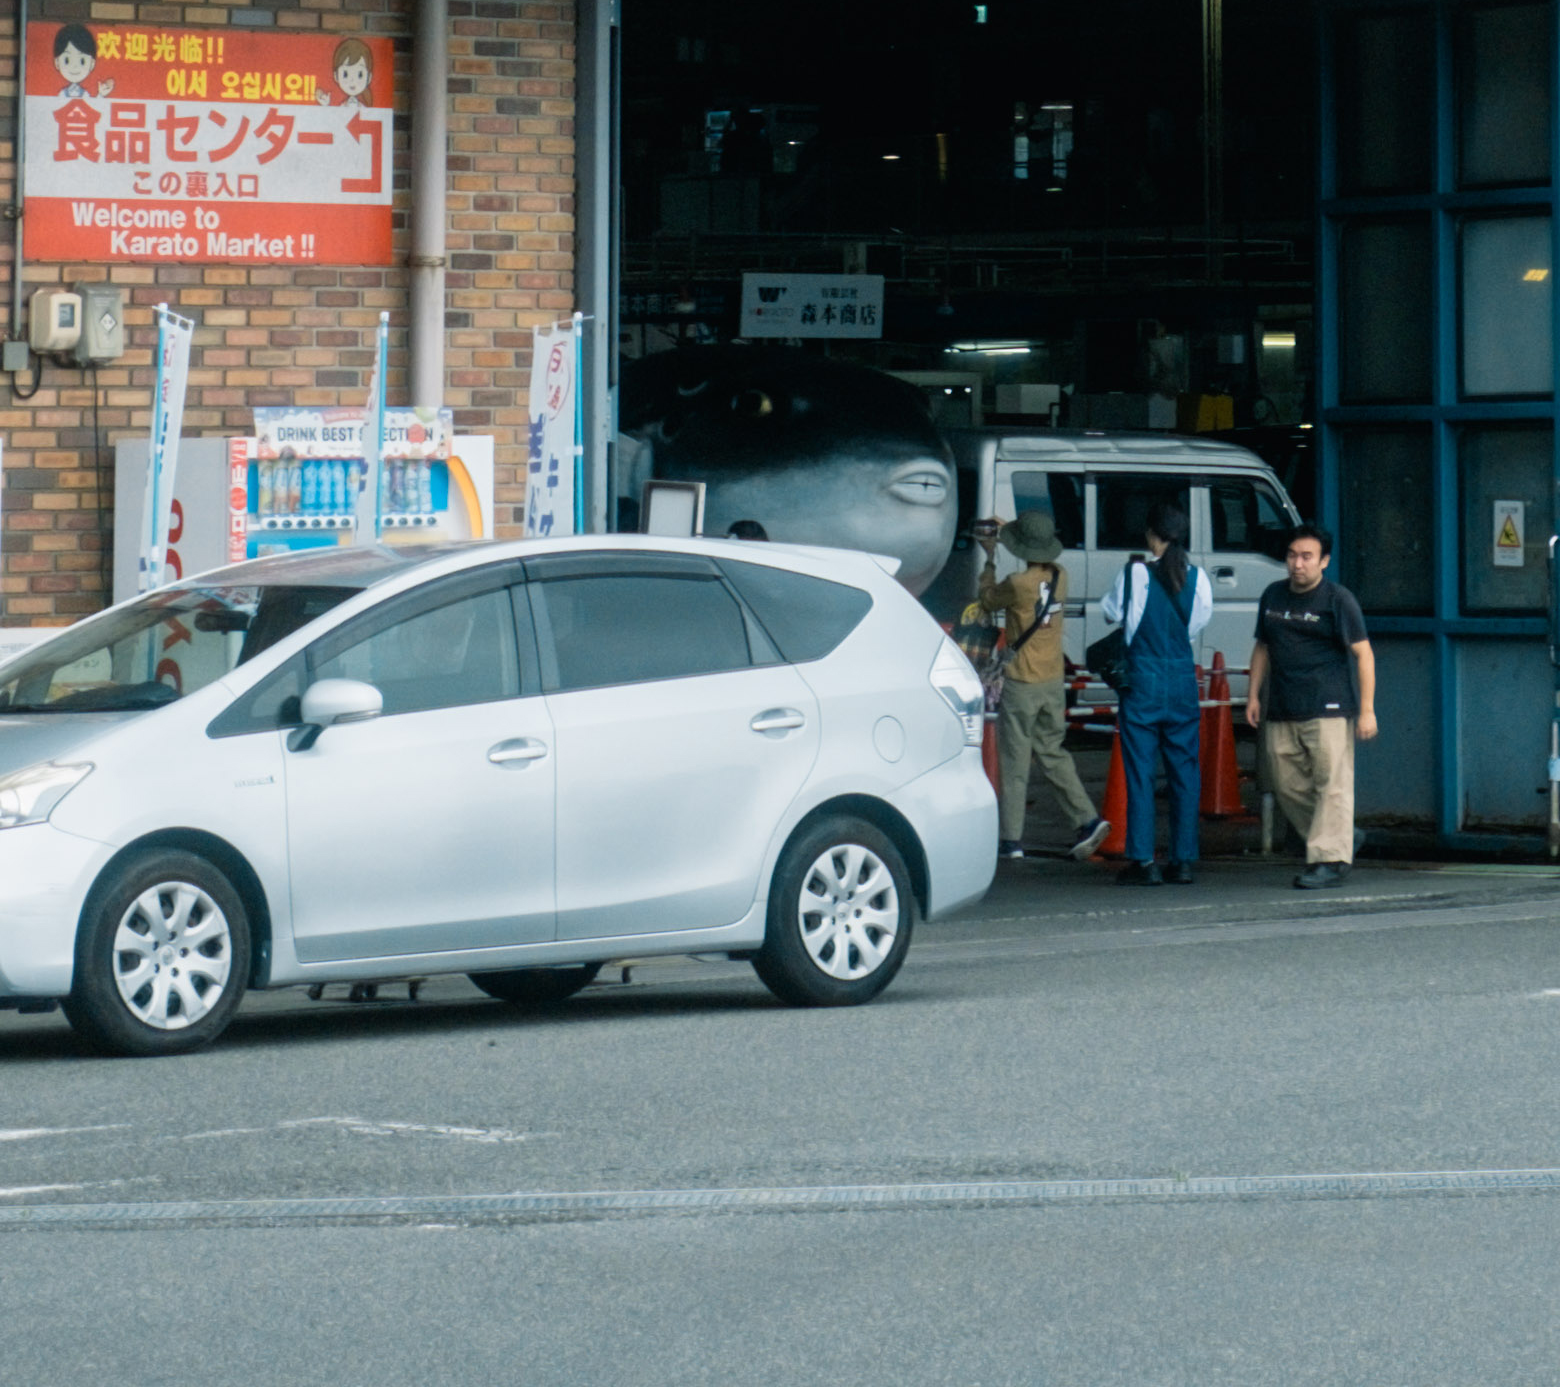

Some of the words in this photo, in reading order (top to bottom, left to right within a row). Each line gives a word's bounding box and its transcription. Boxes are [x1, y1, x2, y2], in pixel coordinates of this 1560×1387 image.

[166, 68, 208, 98] 어서
[220, 71, 317, 102] 오십시오!!
[52, 98, 334, 166] 食品センター
[132, 171, 260, 199] この裏入口
[71, 202, 187, 228] Welcome
[194, 205, 220, 229] to
[110, 230, 199, 256] Karato
[206, 232, 295, 258] Market
[800, 303, 877, 326] 森本商店
[277, 427, 317, 442] DRINK
[322, 427, 353, 442] BEST
